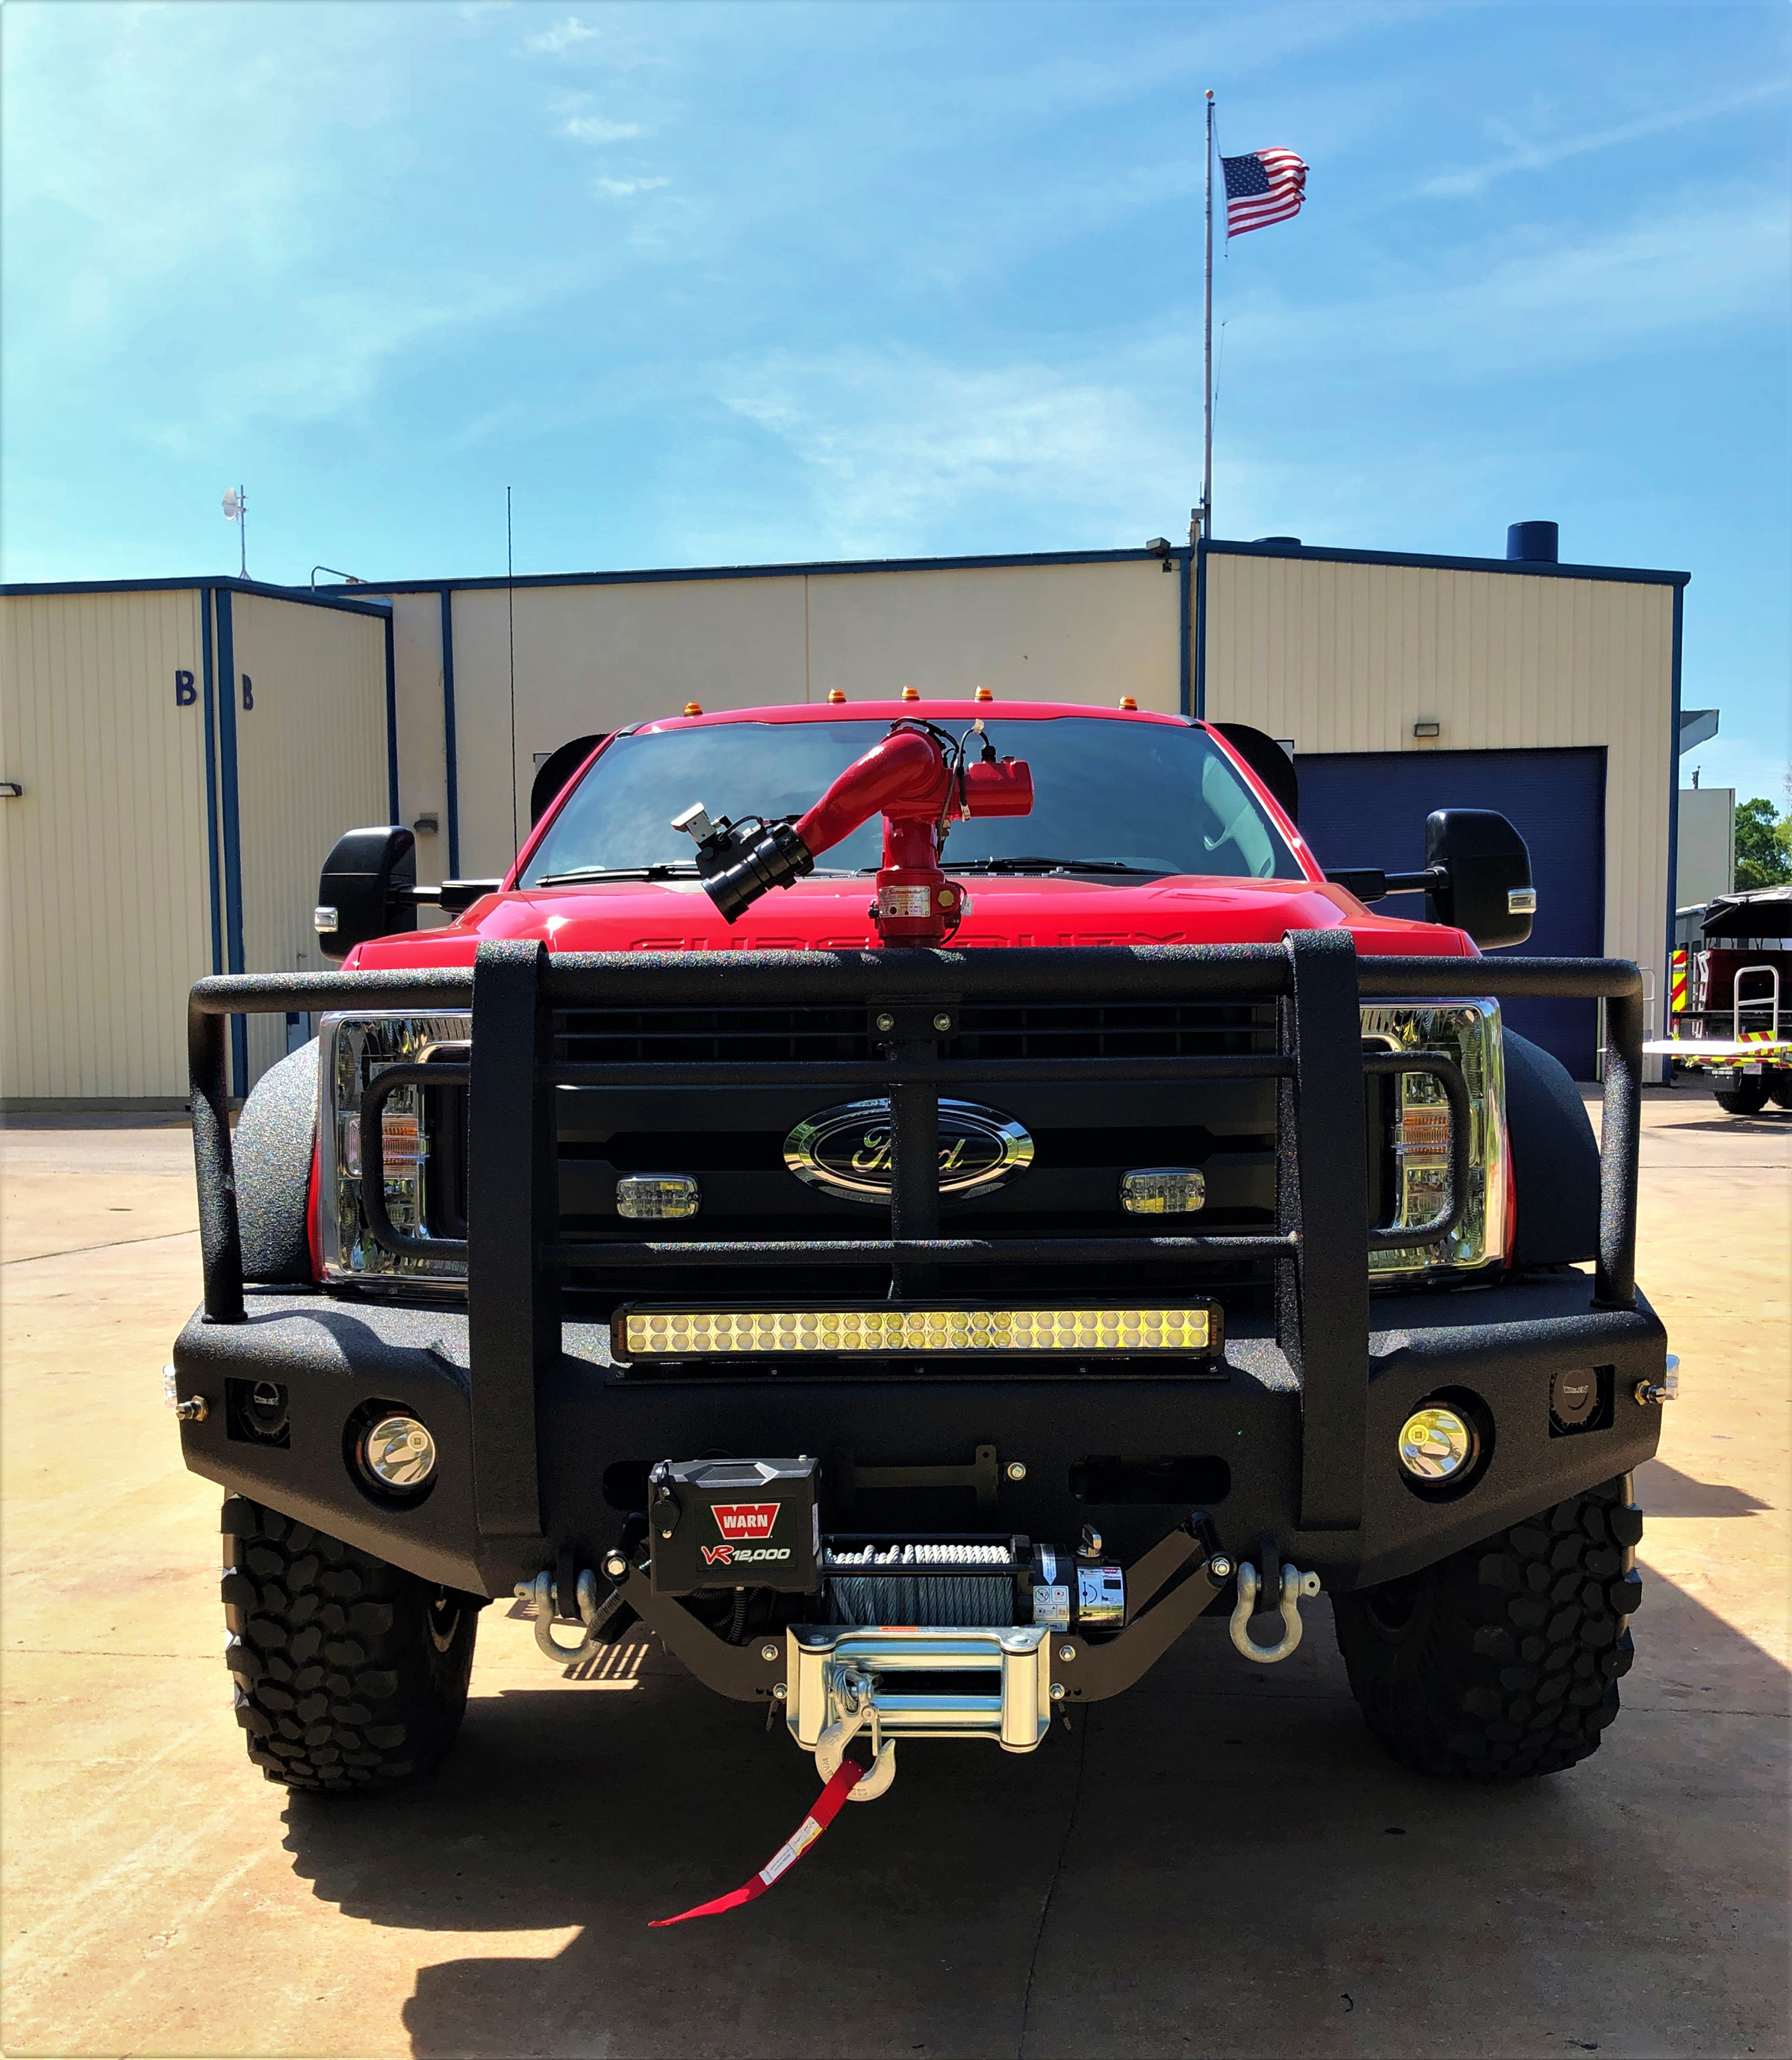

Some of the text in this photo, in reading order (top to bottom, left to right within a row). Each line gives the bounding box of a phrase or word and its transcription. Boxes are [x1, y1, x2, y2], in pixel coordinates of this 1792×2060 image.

[175, 670, 197, 706] B
[242, 673, 254, 711] B
[851, 1126, 966, 1173] Fd
[724, 1514, 768, 1529] WARN
